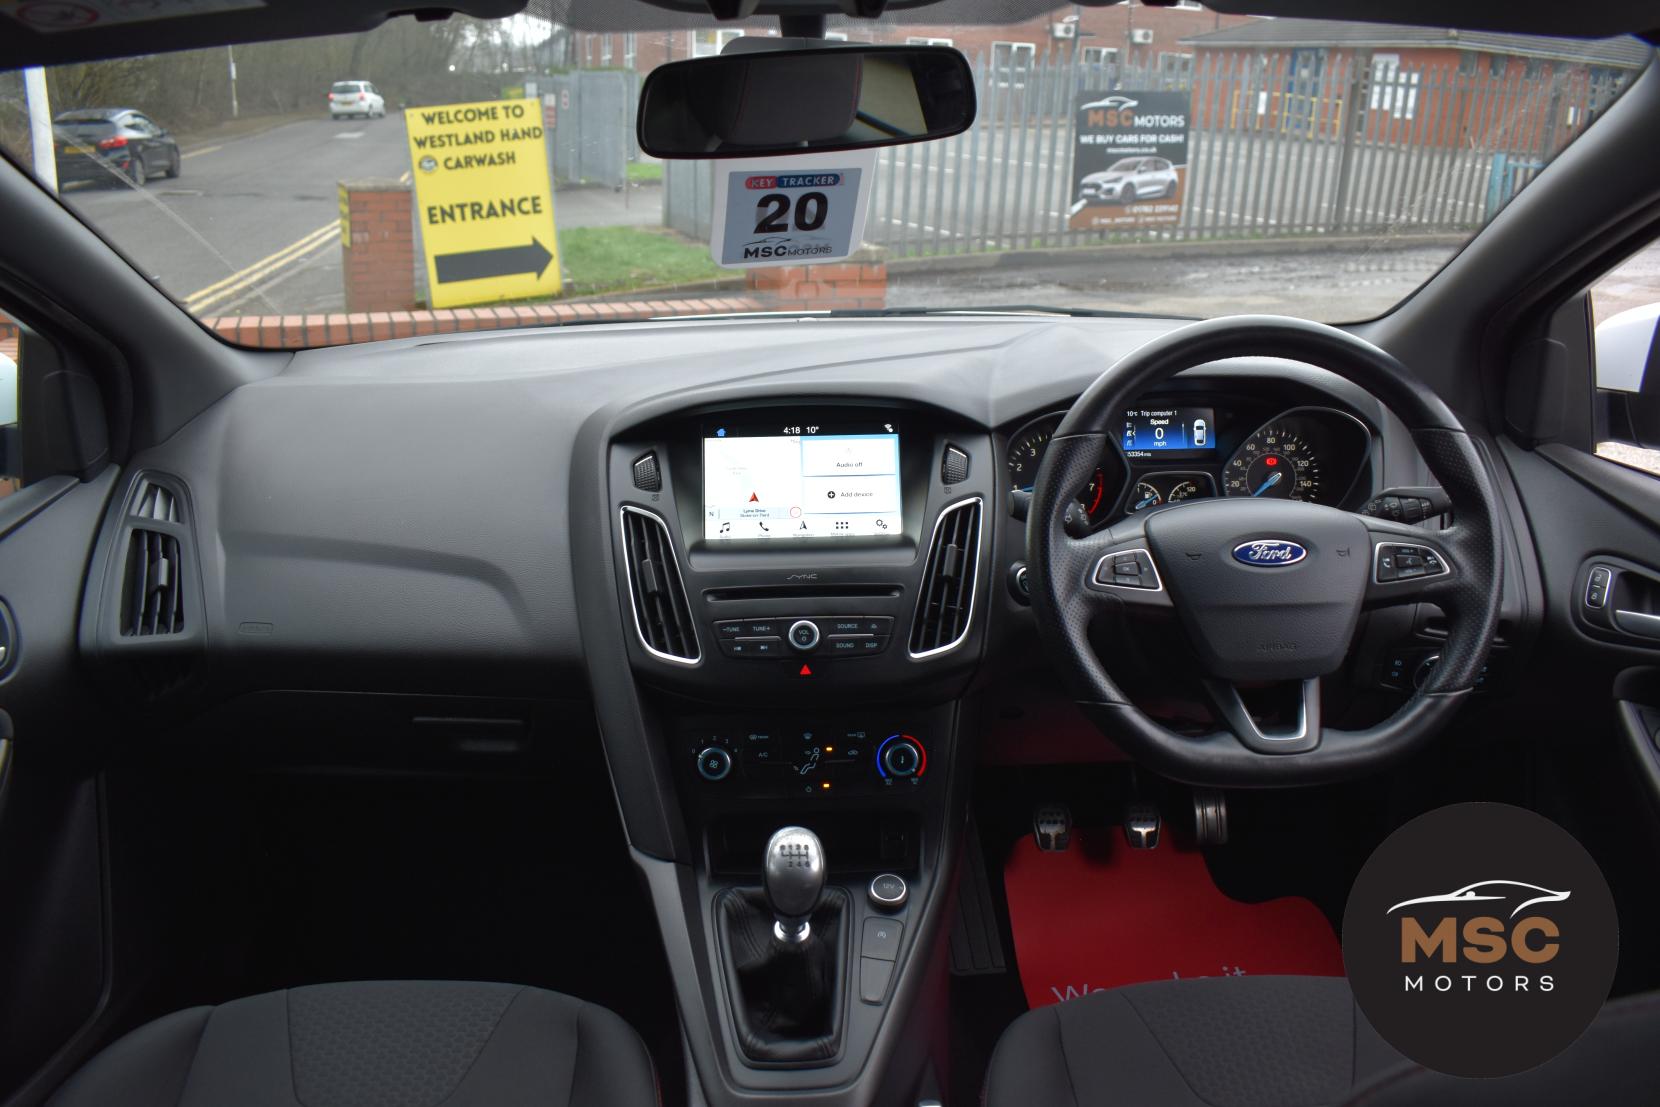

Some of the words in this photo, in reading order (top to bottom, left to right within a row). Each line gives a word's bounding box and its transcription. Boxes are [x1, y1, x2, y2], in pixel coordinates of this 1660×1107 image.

[421, 106, 499, 126] WELCOME
[502, 104, 525, 119] TO
[1087, 108, 1134, 128] MSC
[1134, 115, 1185, 128] MOTORS
[413, 130, 496, 149] WESTLAND
[500, 126, 544, 142] HAND
[1079, 134, 1094, 144] WE
[1095, 134, 1115, 144] BUY
[1115, 134, 1139, 144] CARS
[1140, 134, 1158, 144] FOR
[443, 151, 516, 171] CARWASH
[751, 178, 773, 188] KEY
[782, 175, 835, 187] TRACKER
[427, 195, 543, 225] ENTRANCE
[753, 191, 829, 235] 20
[743, 245, 787, 259] MSC
[787, 246, 833, 257] MOTORS
[1150, 418, 1169, 426] Speed
[783, 426, 801, 435] 4:18
[1154, 427, 1164, 440] 0
[1246, 443, 1256, 451] 60
[1283, 443, 1296, 451] 100
[1030, 448, 1036, 457] 3
[836, 461, 854, 469] Audio
[1016, 463, 1023, 472] 2
[1233, 459, 1242, 467] 40
[1088, 482, 1095, 492] 7
[1230, 480, 1240, 488] 20
[1248, 543, 1292, 560] Ford
